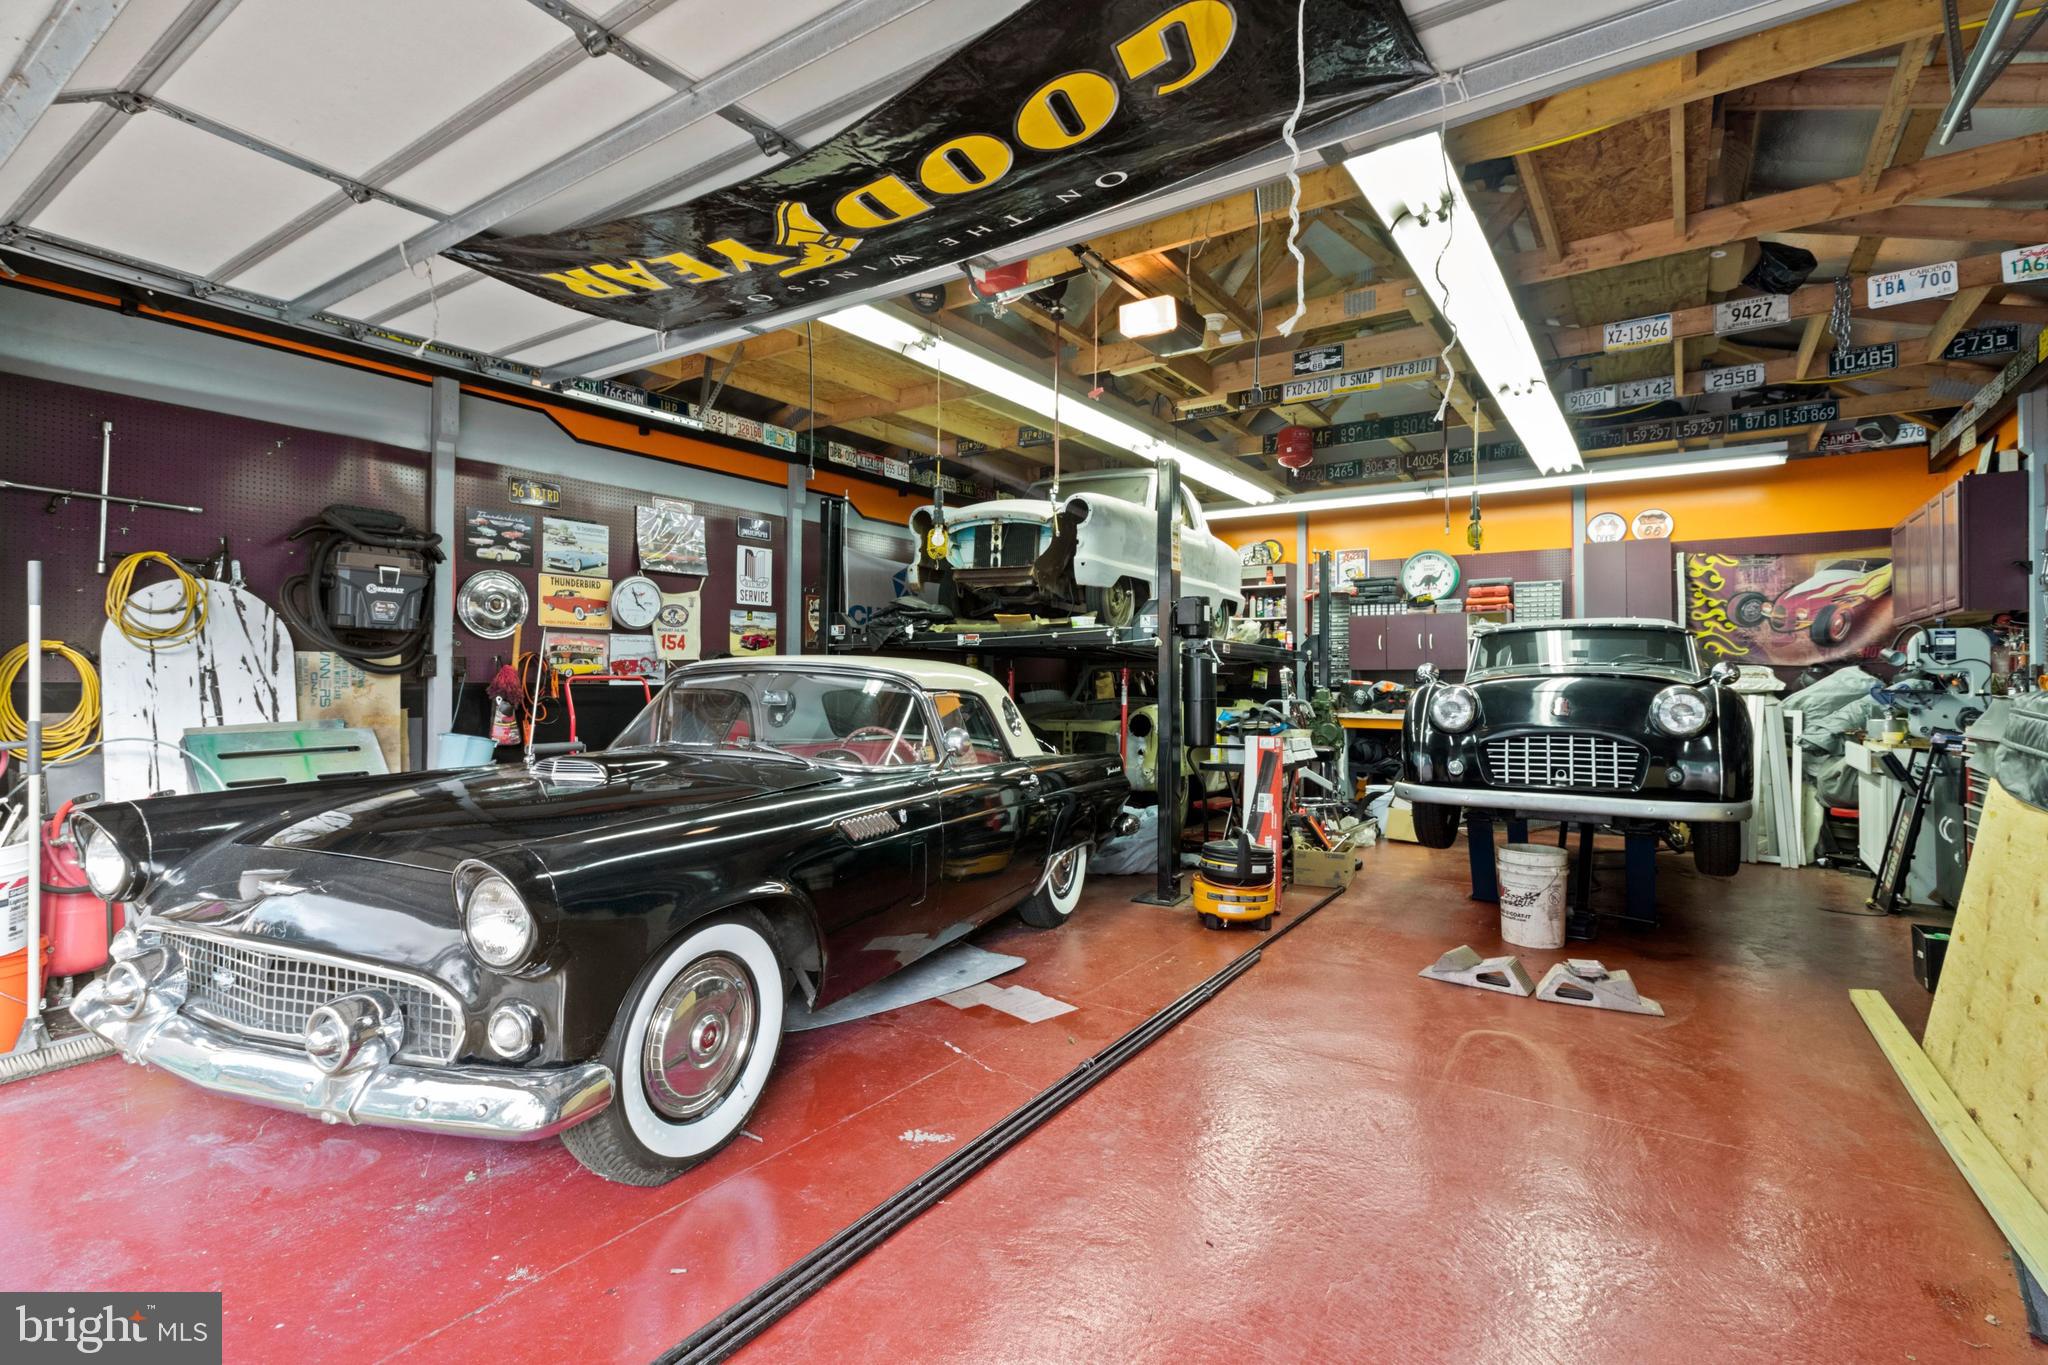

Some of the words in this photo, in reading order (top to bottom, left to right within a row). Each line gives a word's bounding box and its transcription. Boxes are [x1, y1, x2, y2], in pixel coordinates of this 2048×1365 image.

[547, 0, 1237, 299] GOODYEAR
[1055, 171, 1129, 202] ON
[936, 211, 1026, 246] THE
[787, 253, 923, 294] WINGS
[1909, 263, 1955, 277] CAROLINA
[1919, 270, 1952, 289] 700
[1731, 302, 1772, 322] 9427
[1608, 321, 1668, 345] XZ-13966
[1834, 350, 1894, 370] 10485
[1350, 372, 1374, 385] SNAP
[511, 482, 525, 498] 56
[1644, 525, 1662, 536] 66
[377, 586, 405, 594] KOBALT
[551, 576, 601, 590] THUNDERBIRD
[740, 589, 769, 604] SERVICE
[661, 633, 687, 651] 154
